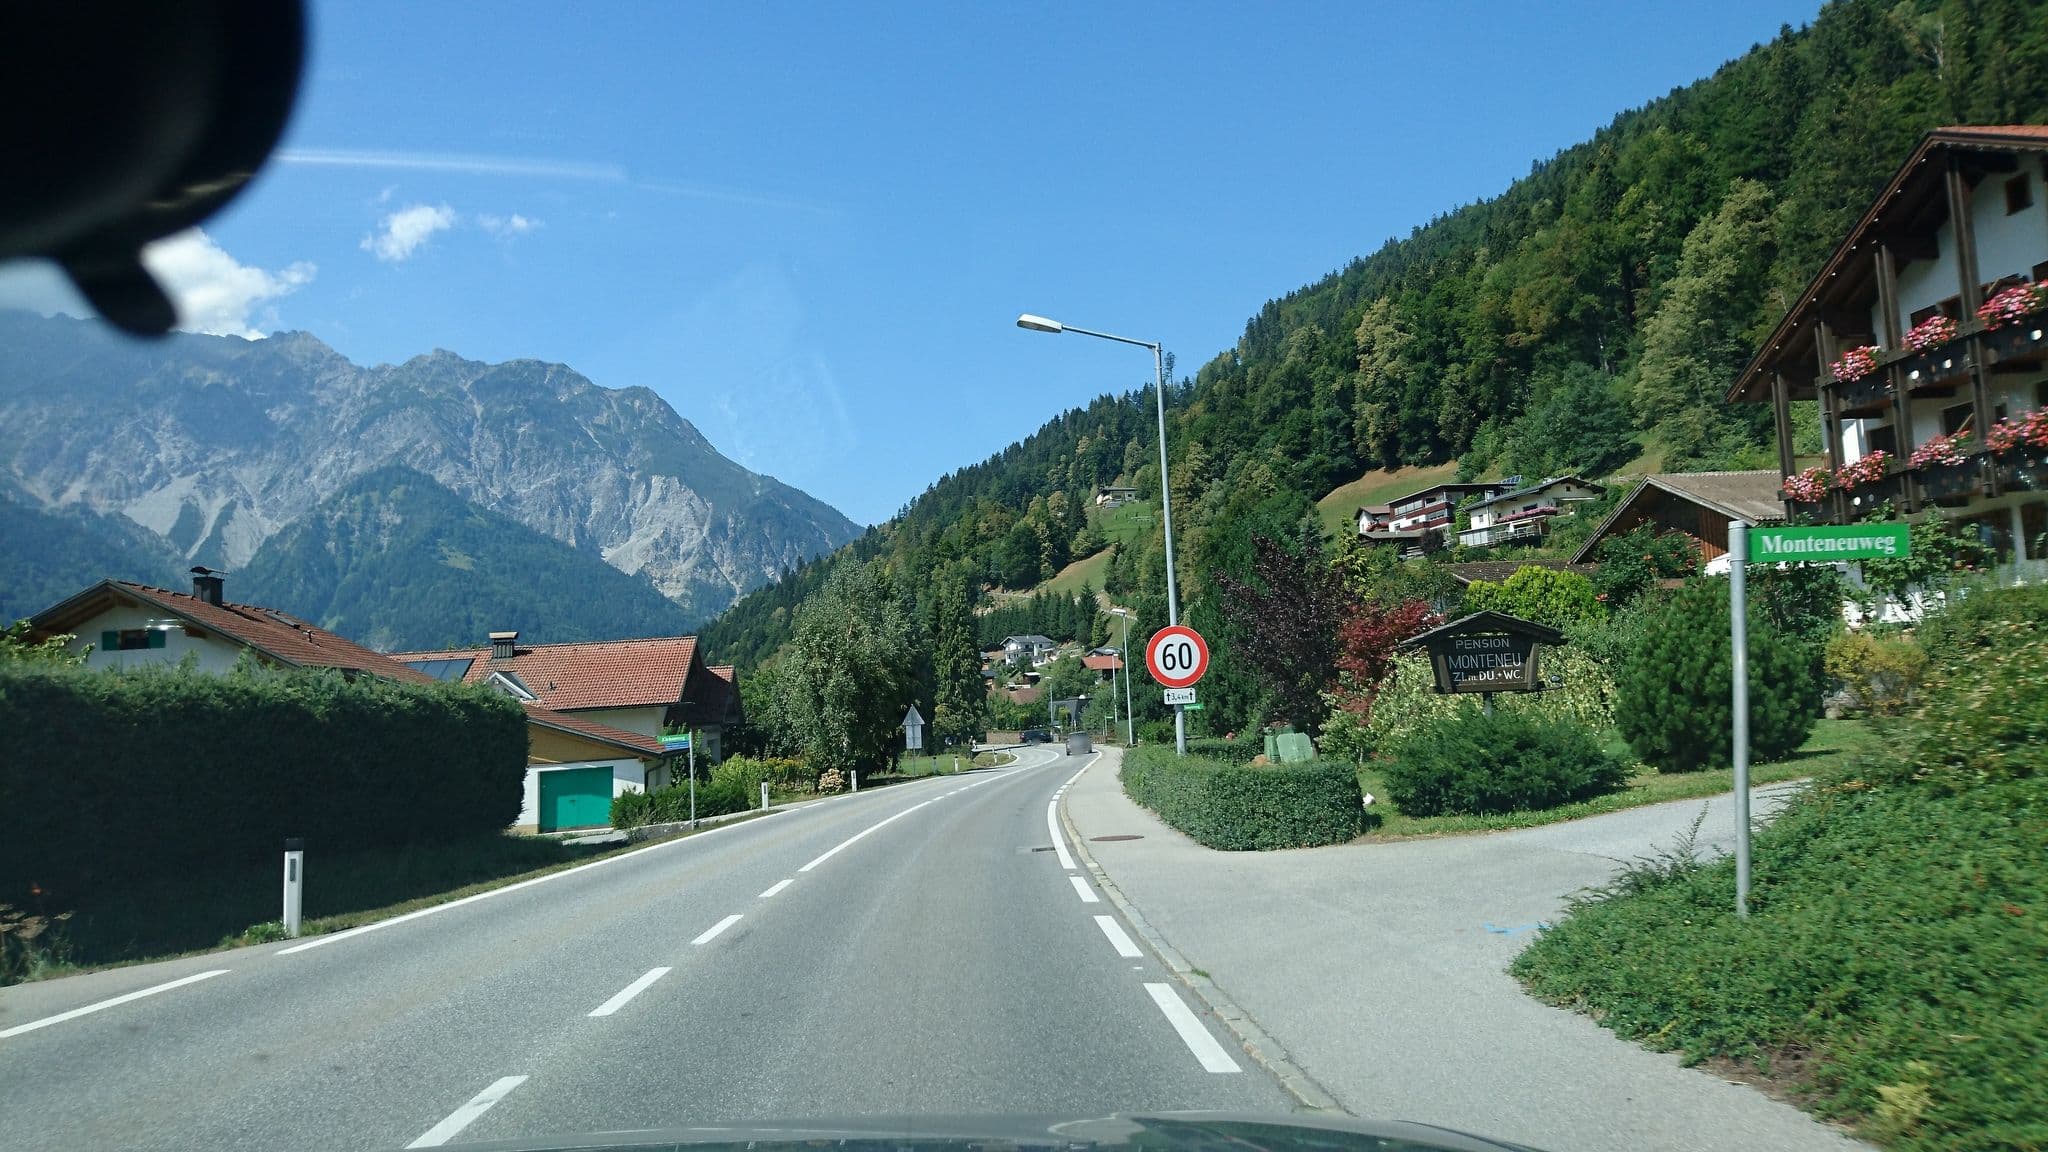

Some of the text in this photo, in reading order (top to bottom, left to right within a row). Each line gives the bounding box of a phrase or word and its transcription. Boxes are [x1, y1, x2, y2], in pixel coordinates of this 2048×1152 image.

[1760, 534, 1897, 555] Monteneuweg
[1456, 638, 1510, 649] PENSION
[1162, 642, 1192, 671] 60
[1449, 653, 1521, 669] MONTENEU
